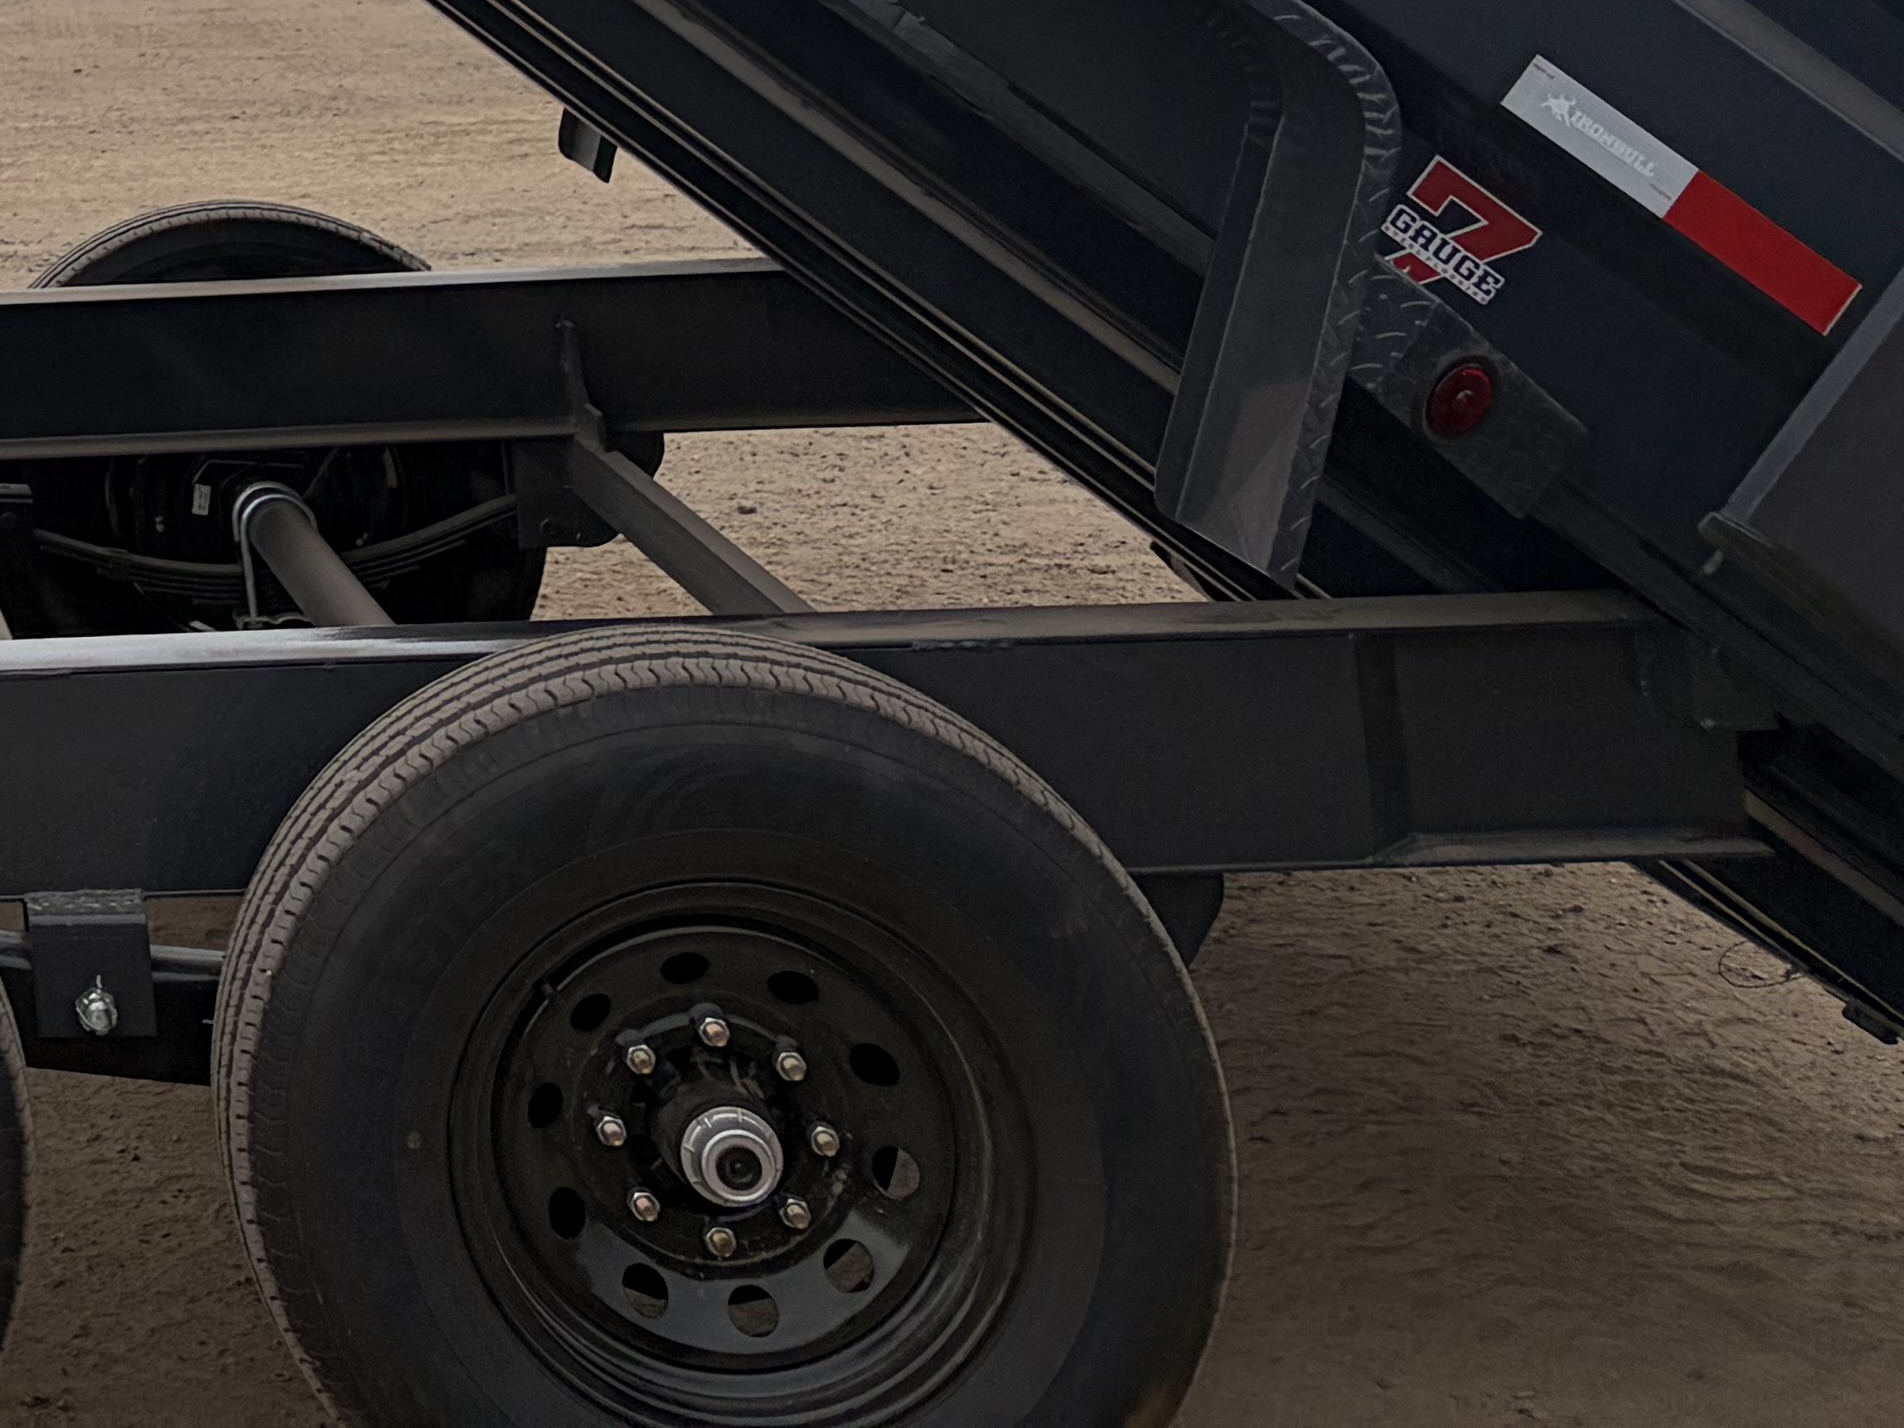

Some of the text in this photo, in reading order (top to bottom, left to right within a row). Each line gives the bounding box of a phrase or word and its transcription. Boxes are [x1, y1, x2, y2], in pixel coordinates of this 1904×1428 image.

[1570, 109, 1657, 179] IRONBULL
[1384, 154, 1543, 285] 7
[1389, 207, 1503, 297] GAUGE
